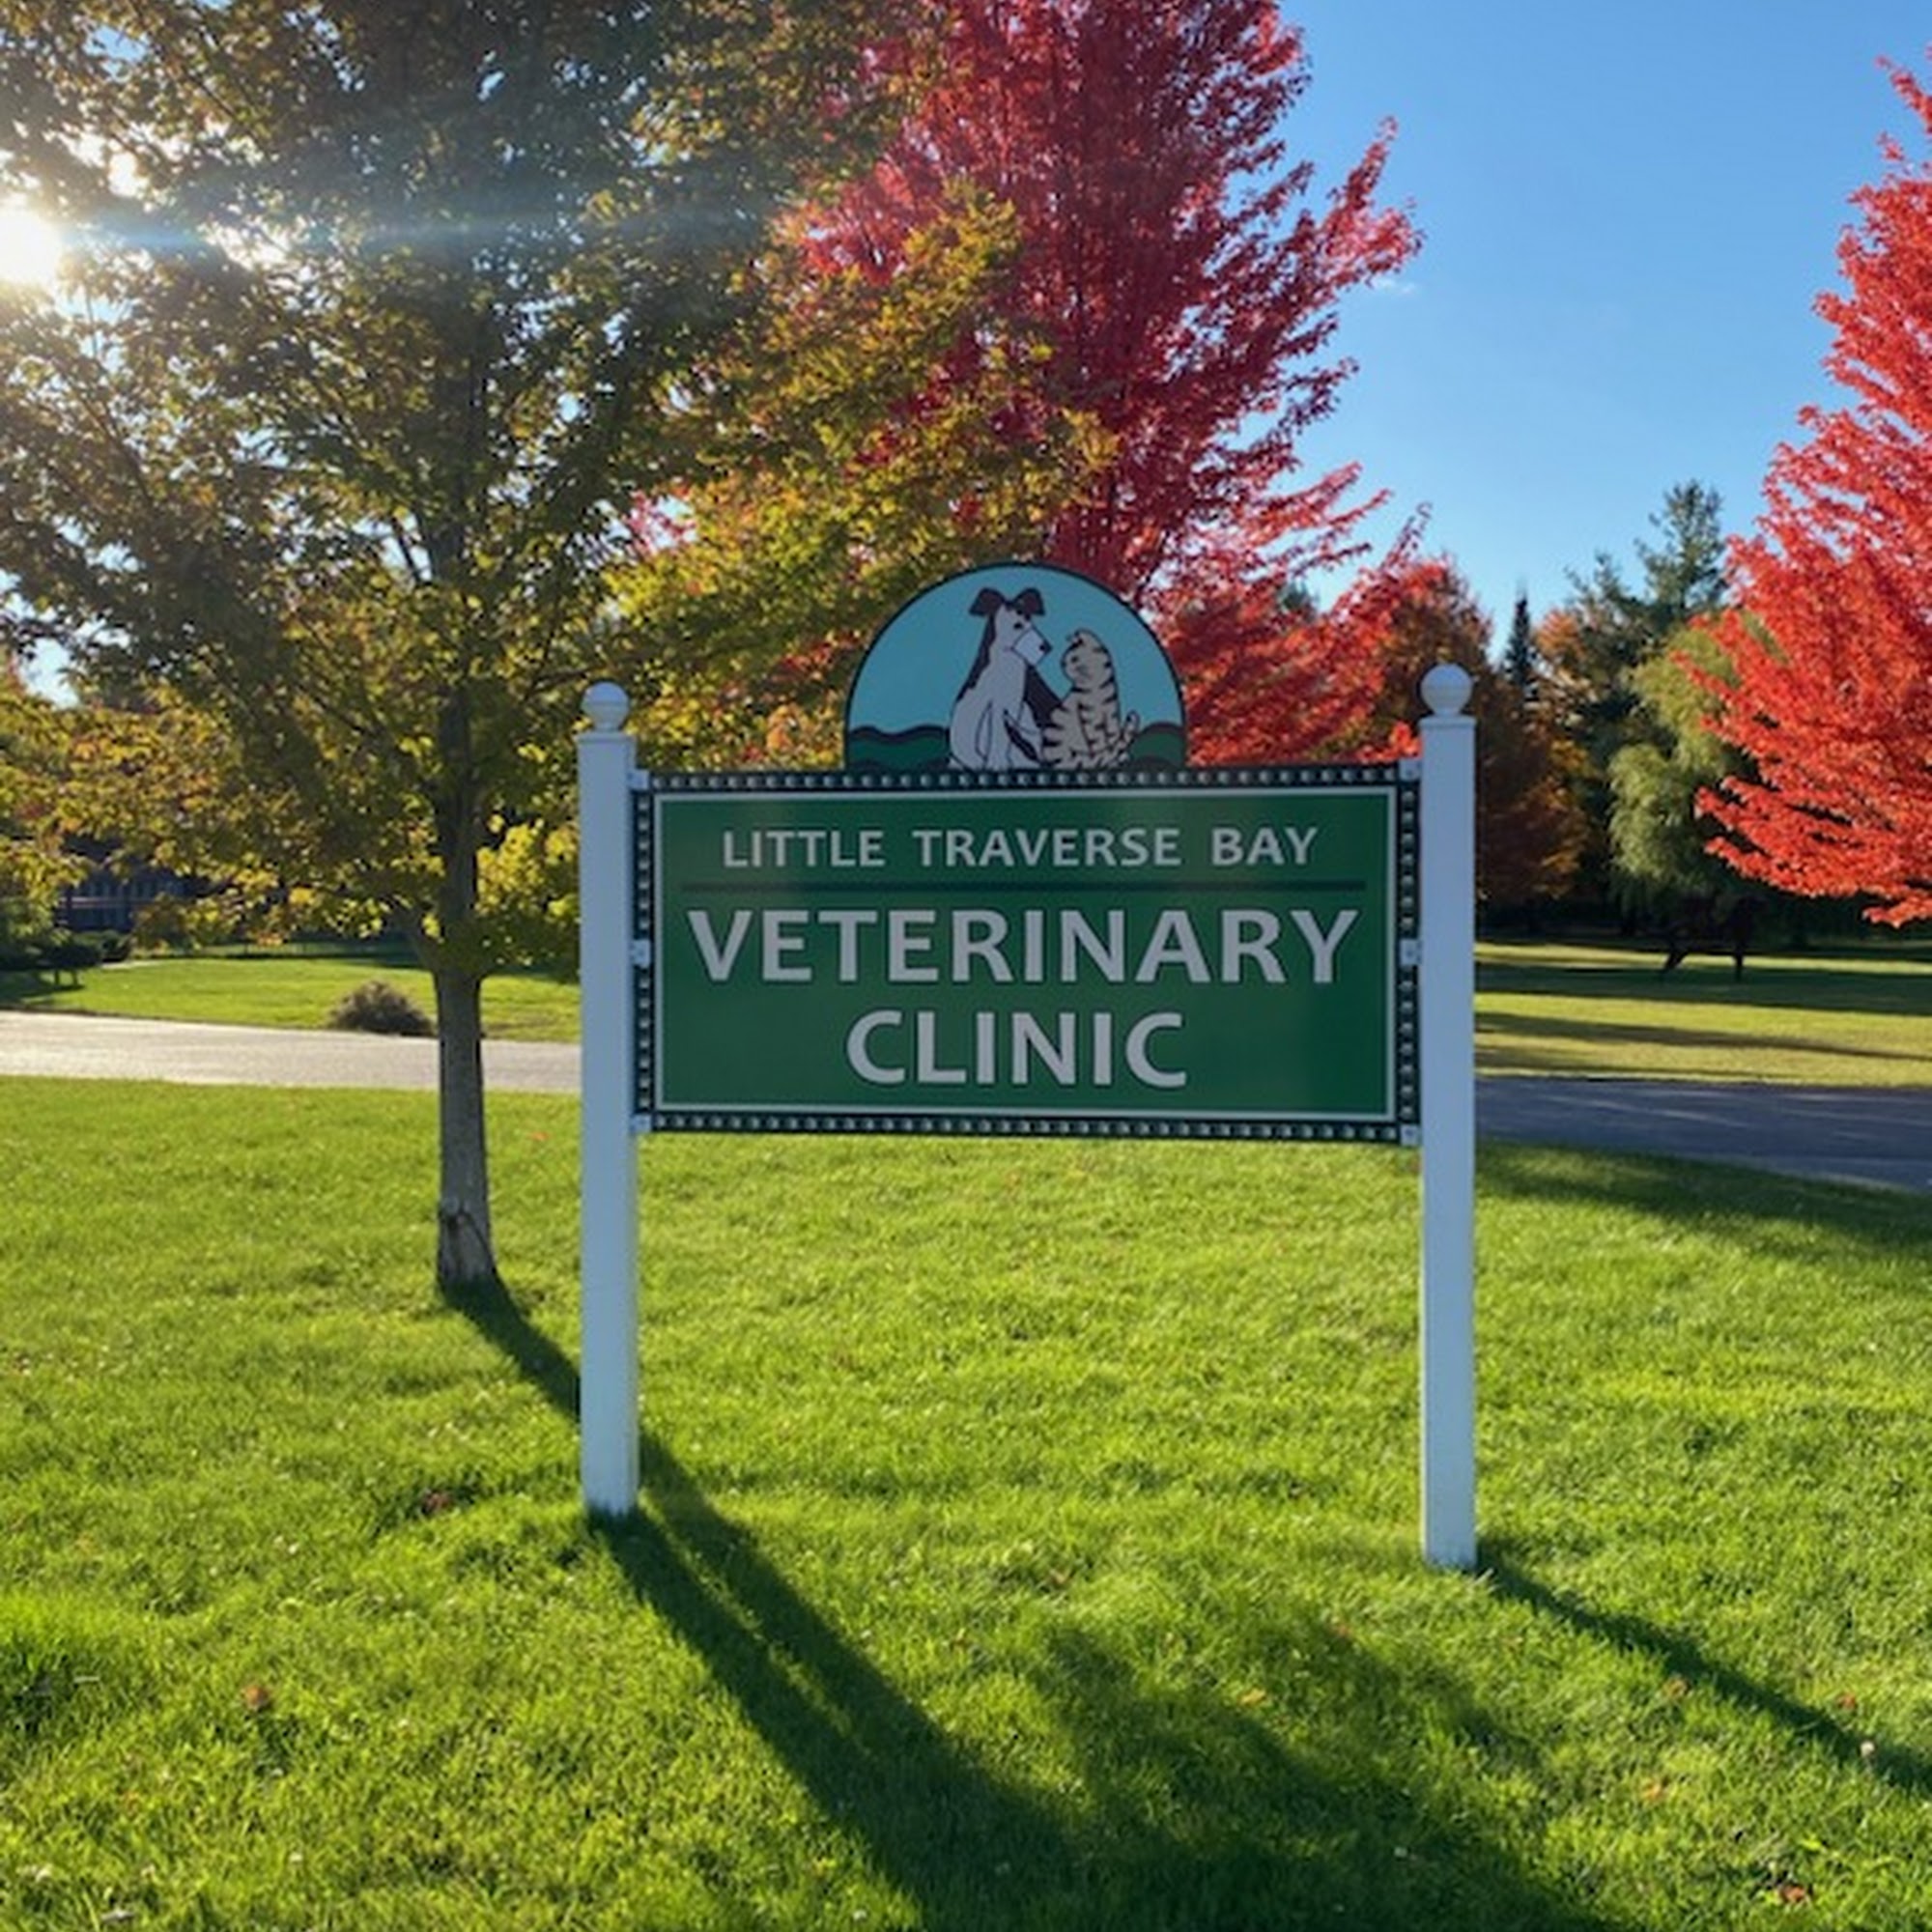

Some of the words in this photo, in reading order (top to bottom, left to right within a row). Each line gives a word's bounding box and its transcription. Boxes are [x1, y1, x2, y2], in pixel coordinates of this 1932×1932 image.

[723, 829, 886, 868] LITTLE
[912, 828, 1182, 868] TRAVERSE
[1211, 826, 1319, 867] BAY
[687, 908, 1359, 984] VETERINARY
[846, 1009, 1187, 1088] CLINIC
